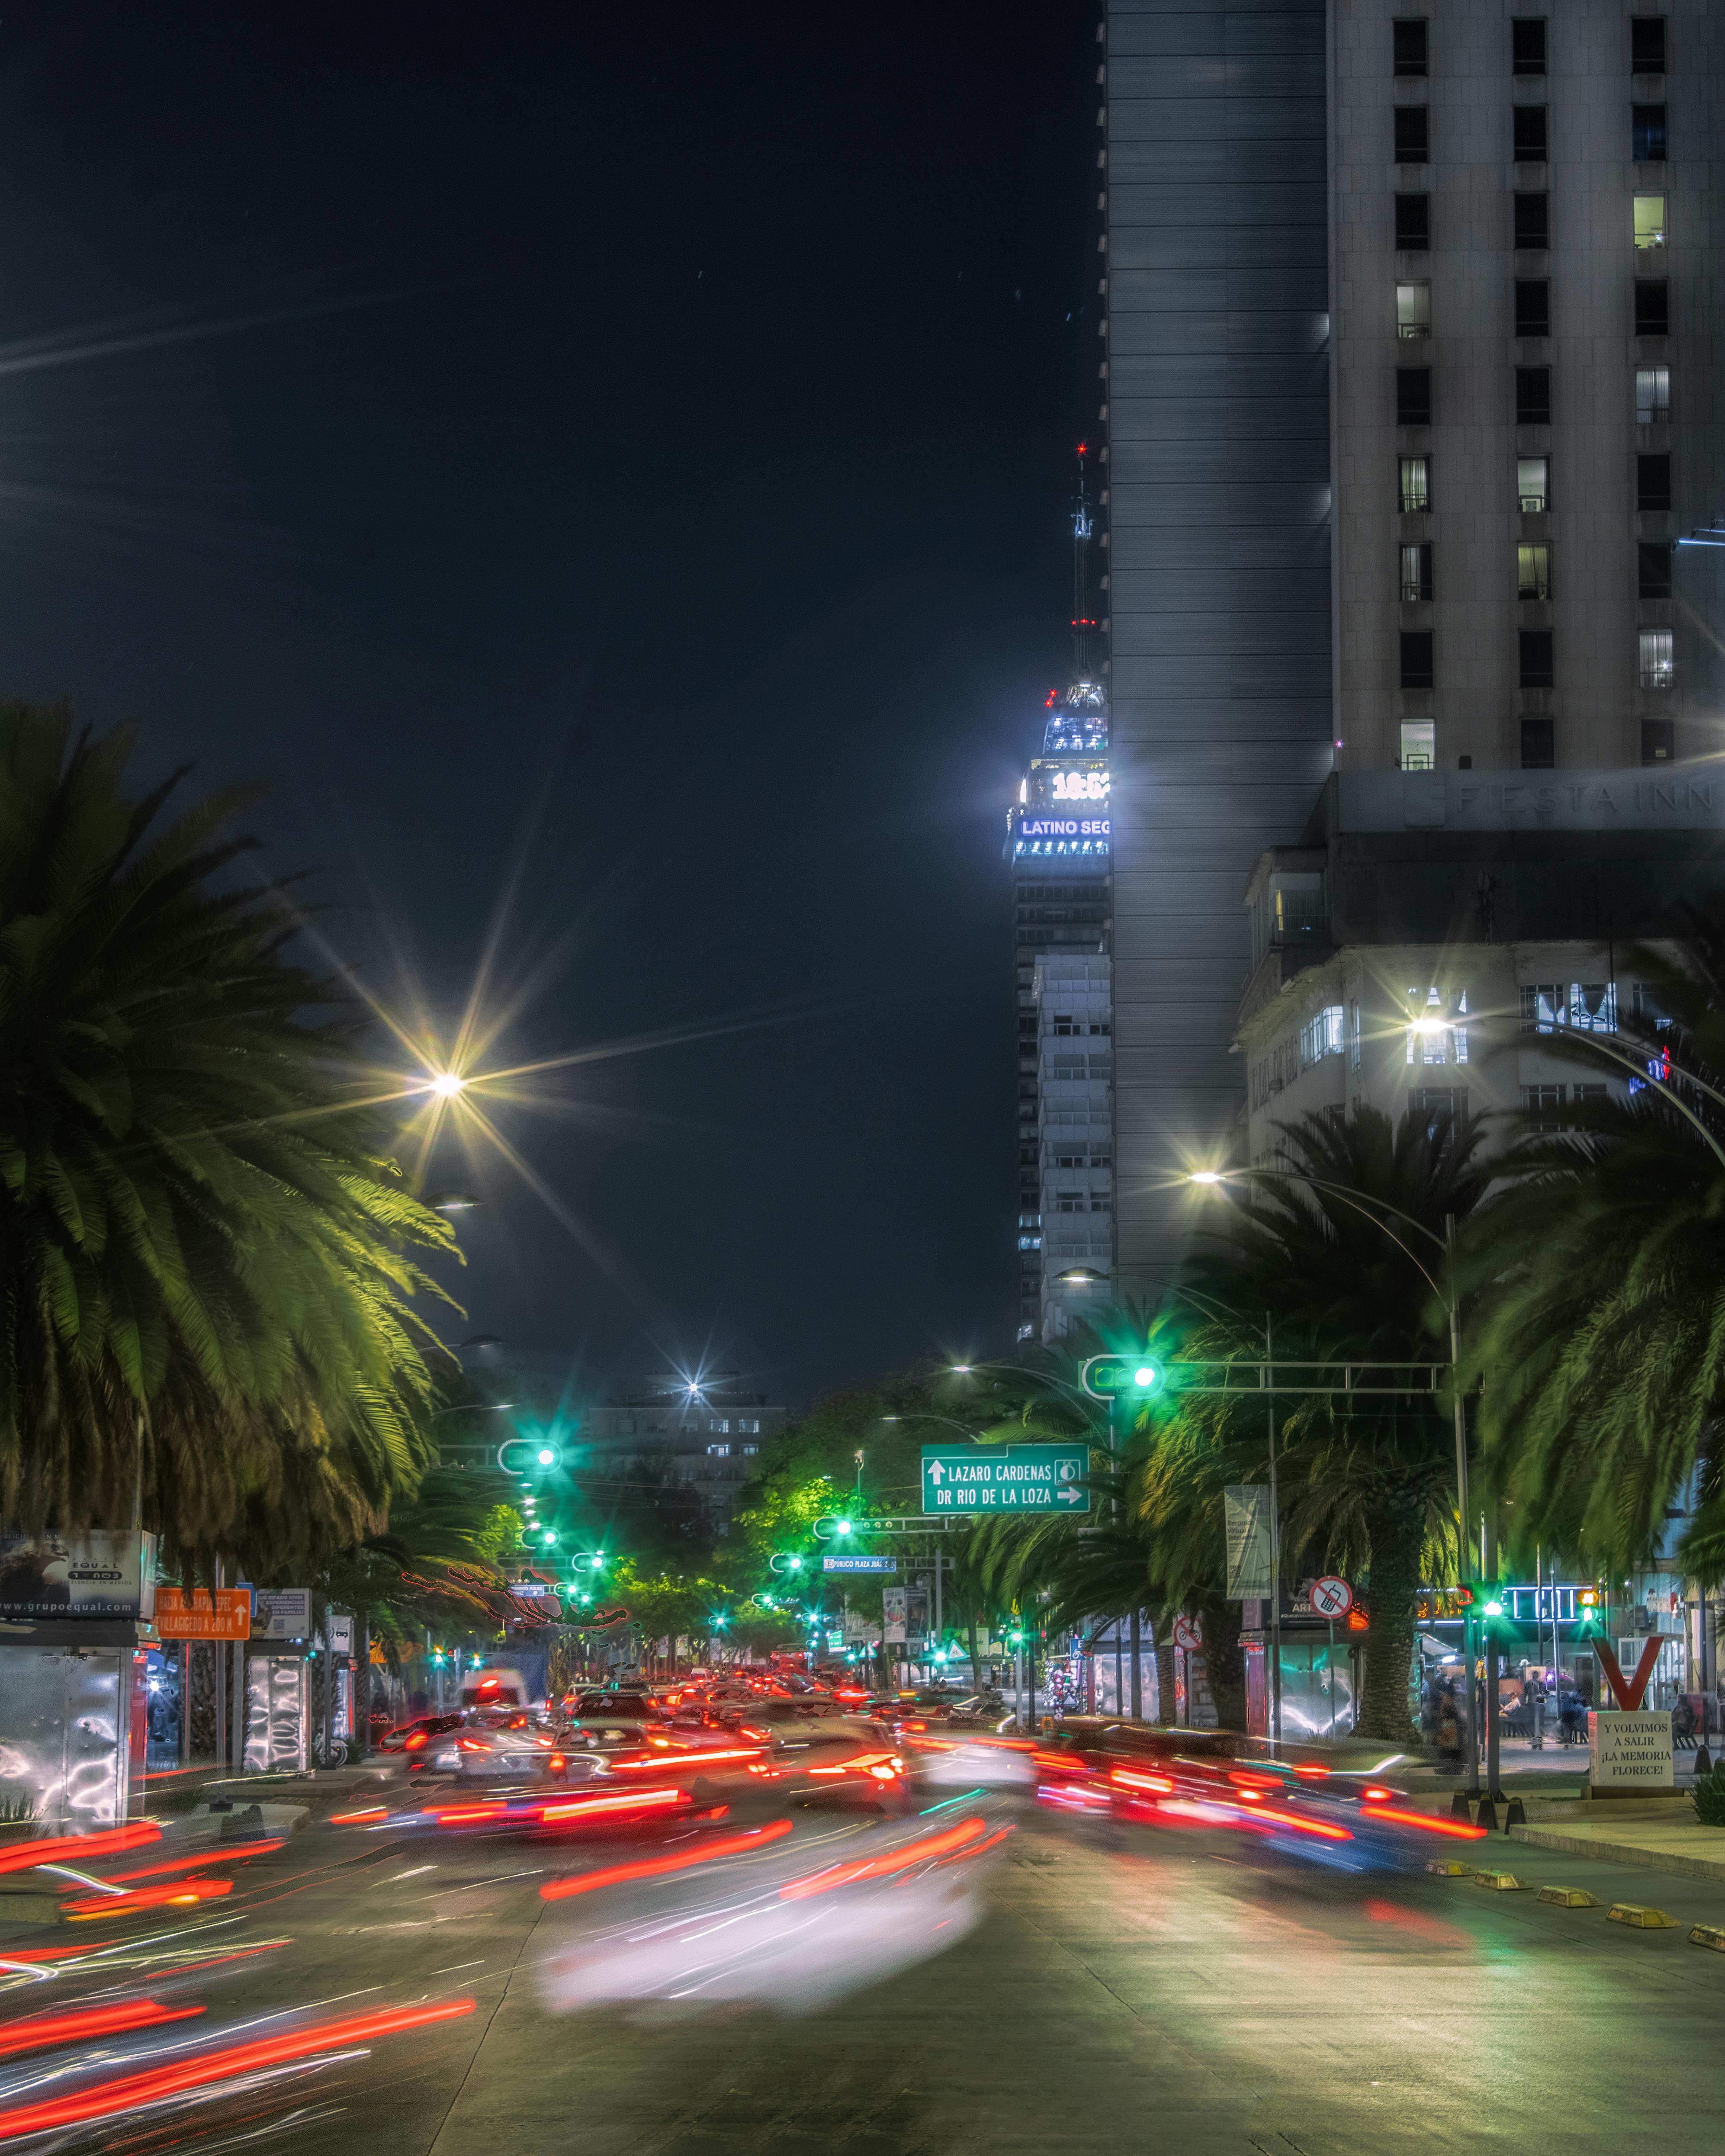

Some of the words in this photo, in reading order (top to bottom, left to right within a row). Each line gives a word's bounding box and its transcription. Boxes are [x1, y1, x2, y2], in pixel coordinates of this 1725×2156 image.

[1458, 785, 1618, 813] FIESTA
[1635, 784, 1712, 812] INN
[1022, 821, 1077, 834] LATINO
[949, 1465, 990, 1481] LAZARO
[996, 1465, 1051, 1481] CARDENAS
[937, 1490, 951, 1505] DR
[957, 1489, 976, 1504] RIO
[982, 1489, 996, 1504] DE
[1002, 1489, 1016, 1504] LA
[1022, 1488, 1051, 1504] LOZA
[834, 1559, 854, 1568] PÚBLICO
[871, 1559, 887, 1568] JUÁRZ
[191, 1596, 232, 1611] HAPULEPEC
[1292, 1603, 1311, 1612] ART
[204, 1617, 209, 1632] A
[212, 1617, 225, 1632] 200
[1605, 1724, 1612, 1733] Y
[1614, 1723, 1667, 1733] VOLVIMOS
[1614, 1737, 1621, 1746] A
[1625, 1737, 1654, 1746] SALIR
[1602, 1752, 1618, 1763] ¡LA
[1621, 1751, 1672, 1761] MEMORIA
[1613, 1766, 1663, 1775] FLORECE!
